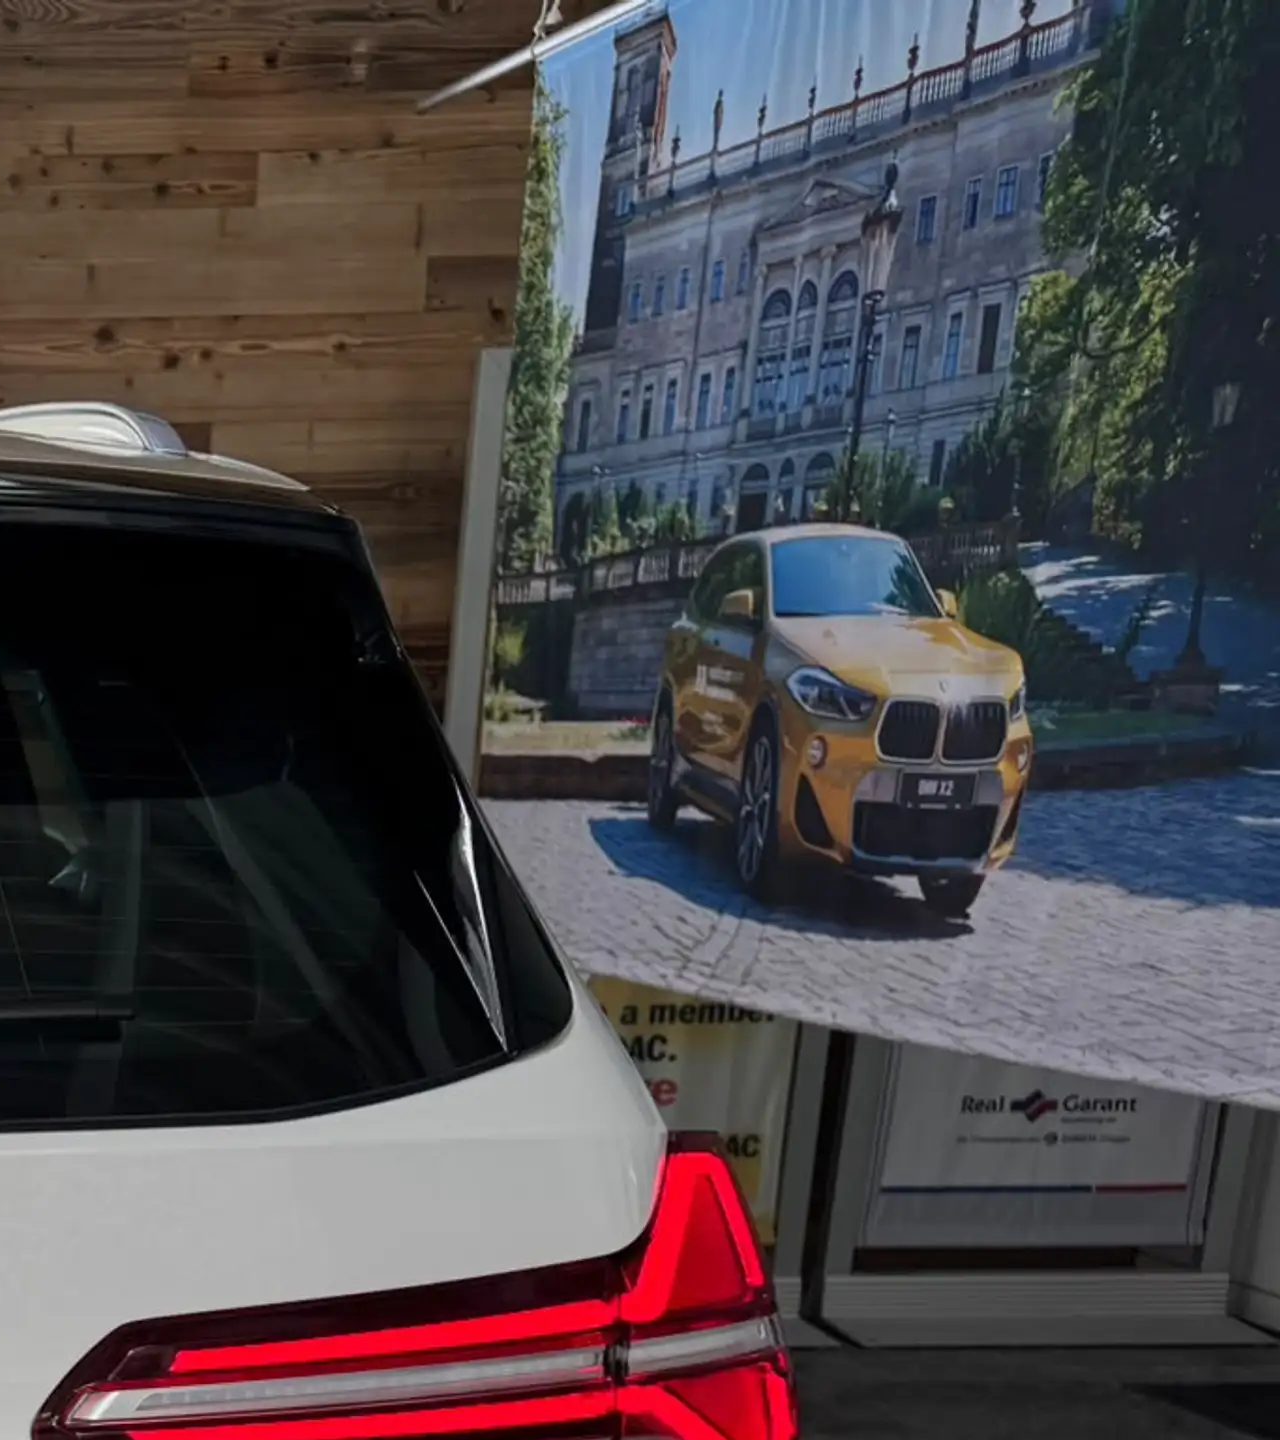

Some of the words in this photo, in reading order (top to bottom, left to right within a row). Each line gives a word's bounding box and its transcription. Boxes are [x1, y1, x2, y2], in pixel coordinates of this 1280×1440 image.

[620, 1004, 639, 1025] a
[620, 1034, 678, 1063] AC.
[960, 1095, 1006, 1114] Real
[1062, 1094, 1138, 1113] Garant
